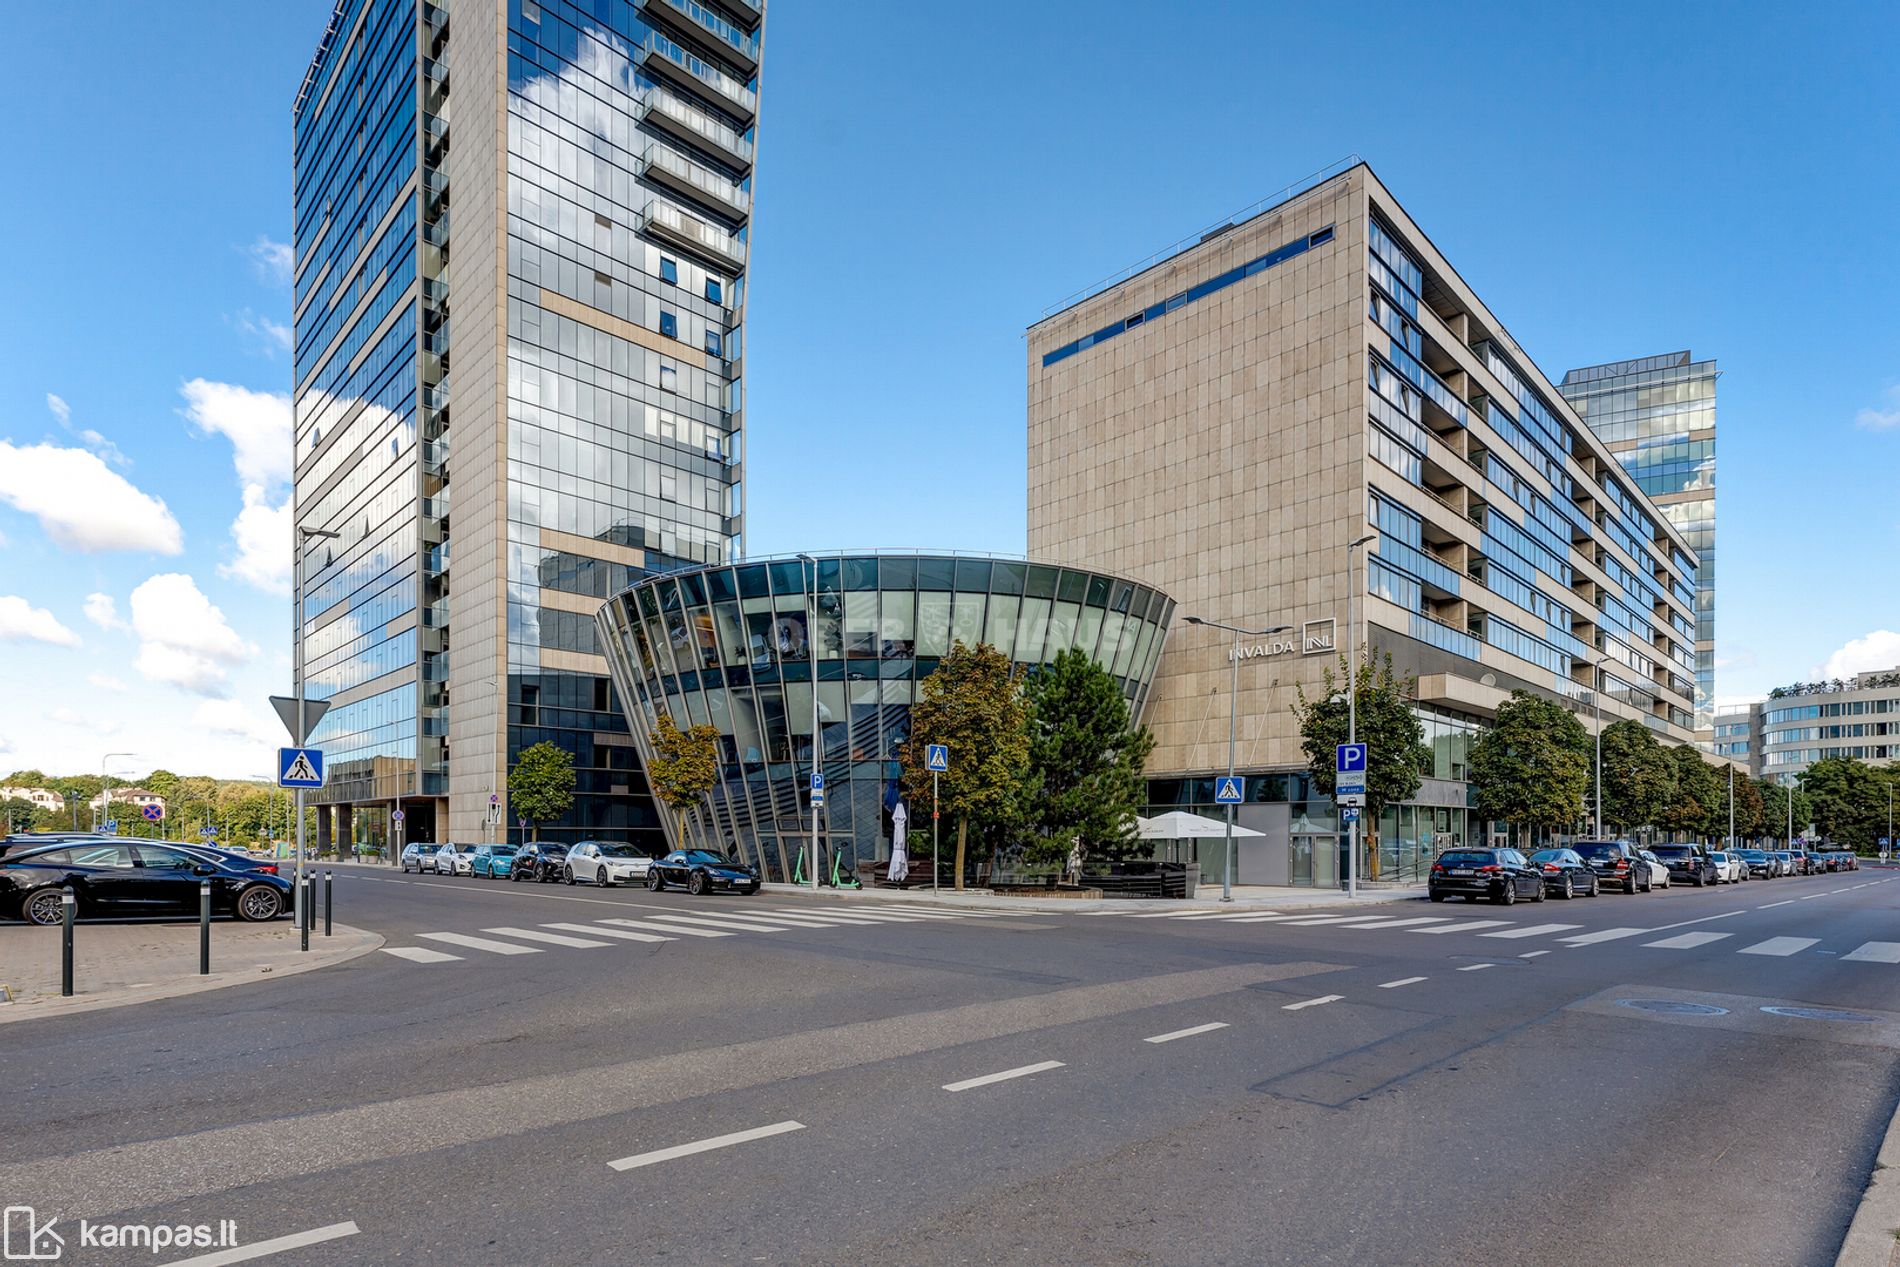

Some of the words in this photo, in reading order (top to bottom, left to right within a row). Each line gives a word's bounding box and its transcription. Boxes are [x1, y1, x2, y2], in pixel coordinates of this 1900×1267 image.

[1229, 641, 1294, 660] INVALDA
[1344, 747, 1361, 769] P
[814, 776, 822, 788] P
[1343, 809, 1351, 821] P
